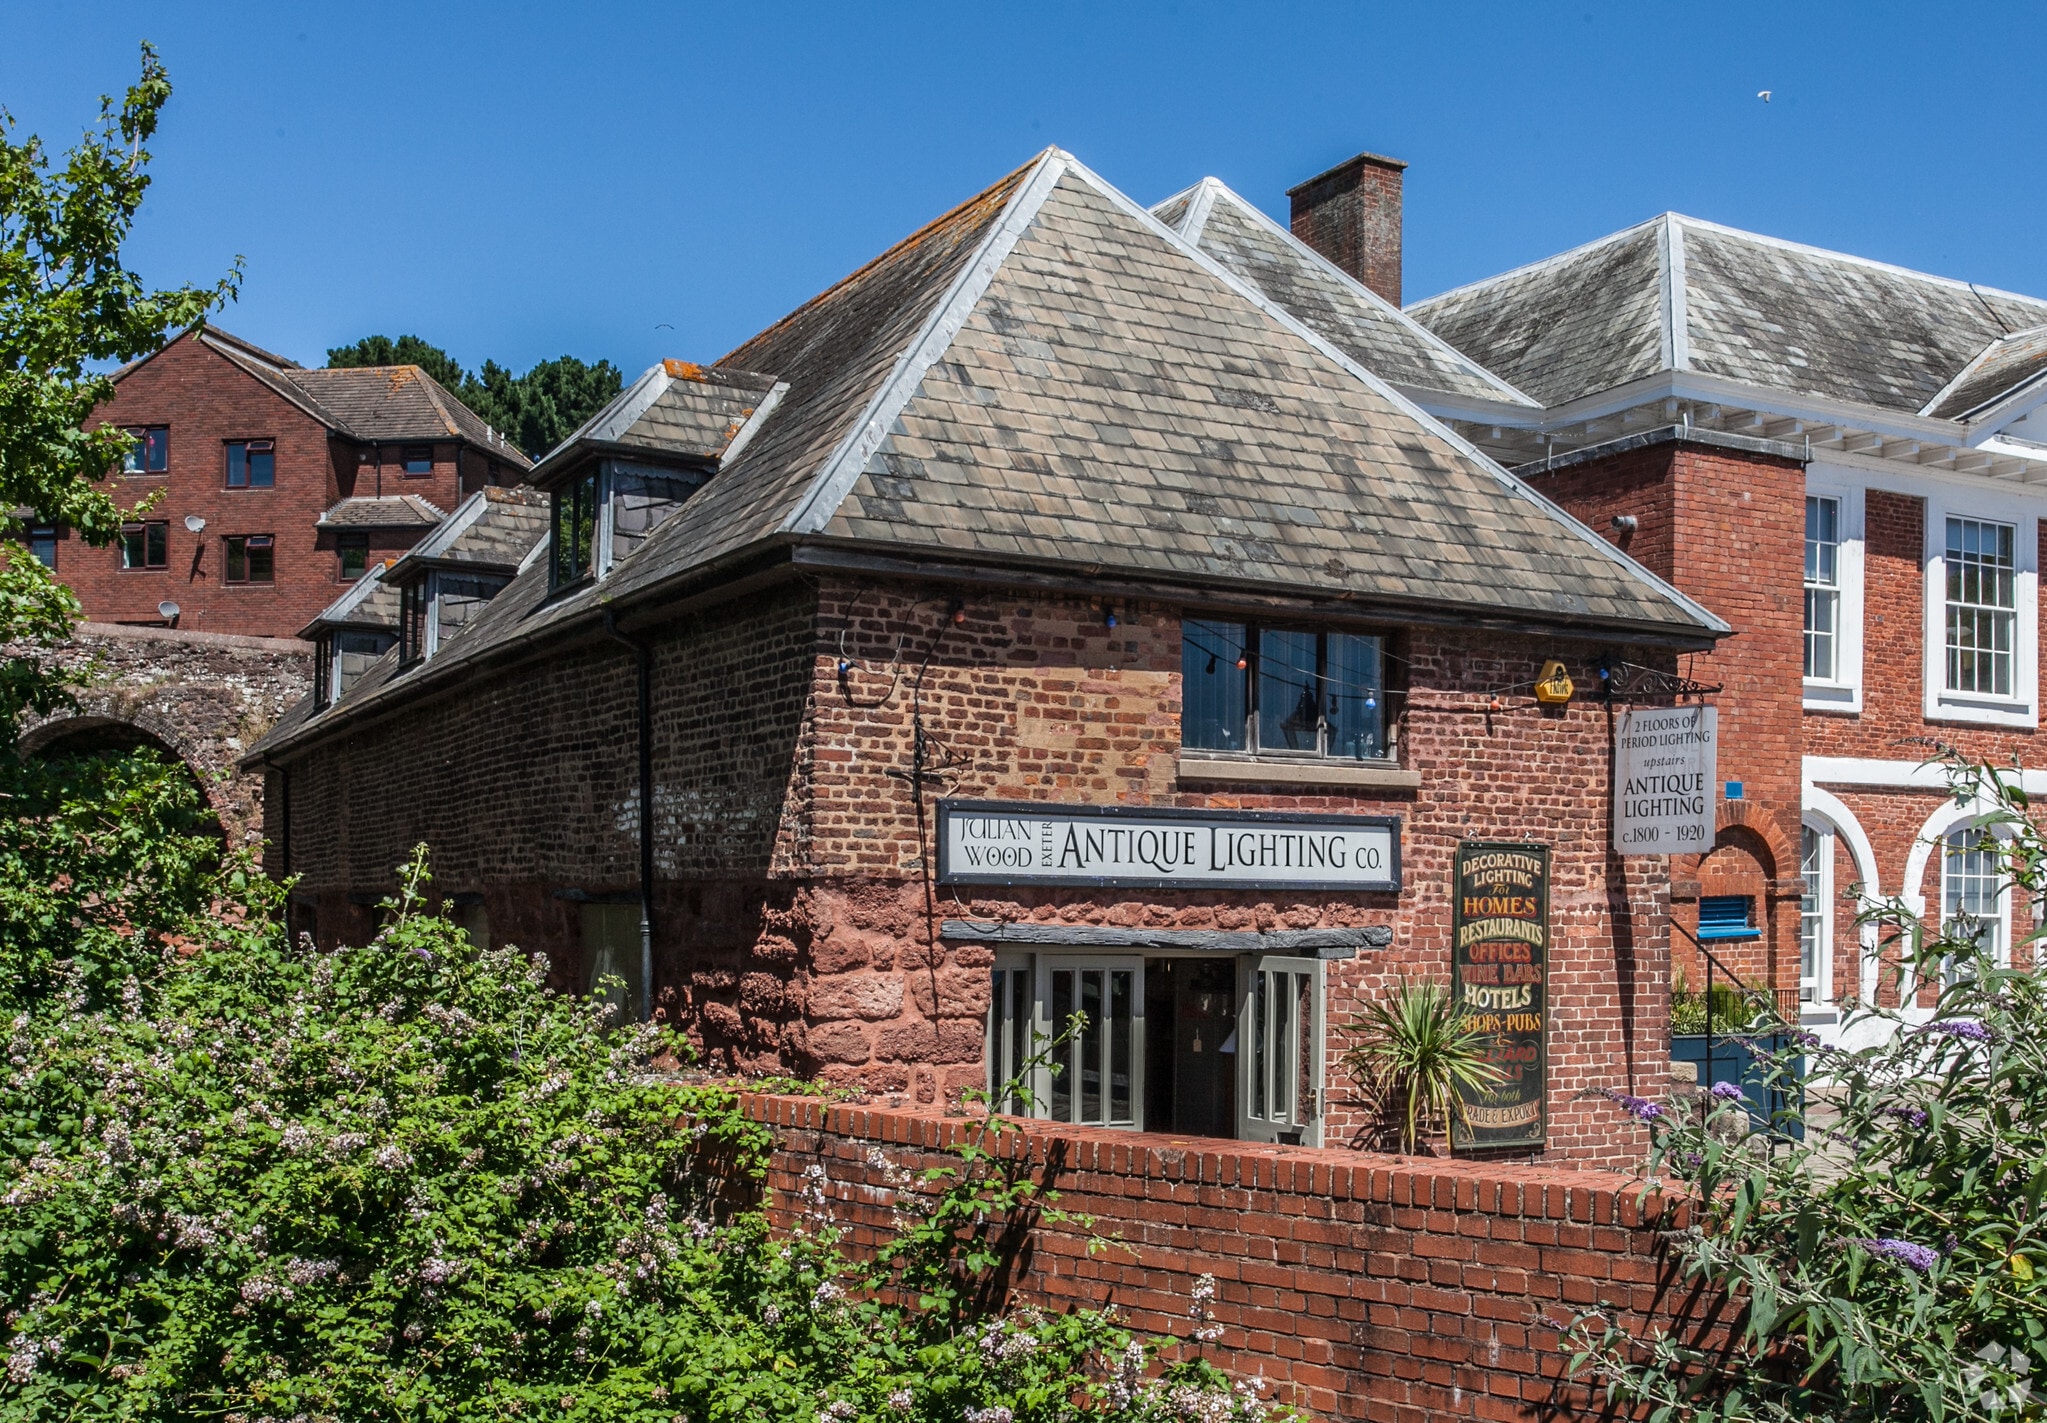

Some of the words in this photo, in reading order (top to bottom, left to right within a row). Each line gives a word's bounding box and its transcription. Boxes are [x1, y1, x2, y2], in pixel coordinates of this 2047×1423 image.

[1635, 721, 1640, 732] 2
[1642, 717, 1680, 732] FLOORS
[1682, 716, 1696, 729] OF
[1621, 736, 1657, 749] PERIOD
[1659, 730, 1710, 746] LIGHTING
[1643, 753, 1685, 770] upstairs
[1623, 773, 1704, 796] ANTIQUE
[1624, 796, 1705, 818] LIGHTING
[961, 818, 1032, 841] JULIAN
[1622, 826, 1659, 843] c.1800
[1676, 824, 1705, 841] 1920
[1042, 821, 1053, 867] EXETER
[1057, 821, 1196, 873] ANTIQUE
[1207, 827, 1347, 872] LIGHTING
[1355, 847, 1382, 869] CO.
[964, 845, 1032, 868] WOOD
[1462, 853, 1542, 876] DECORATIVE
[1474, 869, 1533, 888] LIGHTING
[1490, 883, 1510, 895] For
[1463, 896, 1537, 917] HOMES
[1460, 917, 1543, 948] RESTAURANTS
[1469, 942, 1532, 963] OFFICES
[1459, 964, 1500, 985] WINE
[1503, 964, 1542, 985] BARS
[1464, 982, 1532, 1010] HOTELS
[1501, 1102, 1536, 1123] EXPORT
